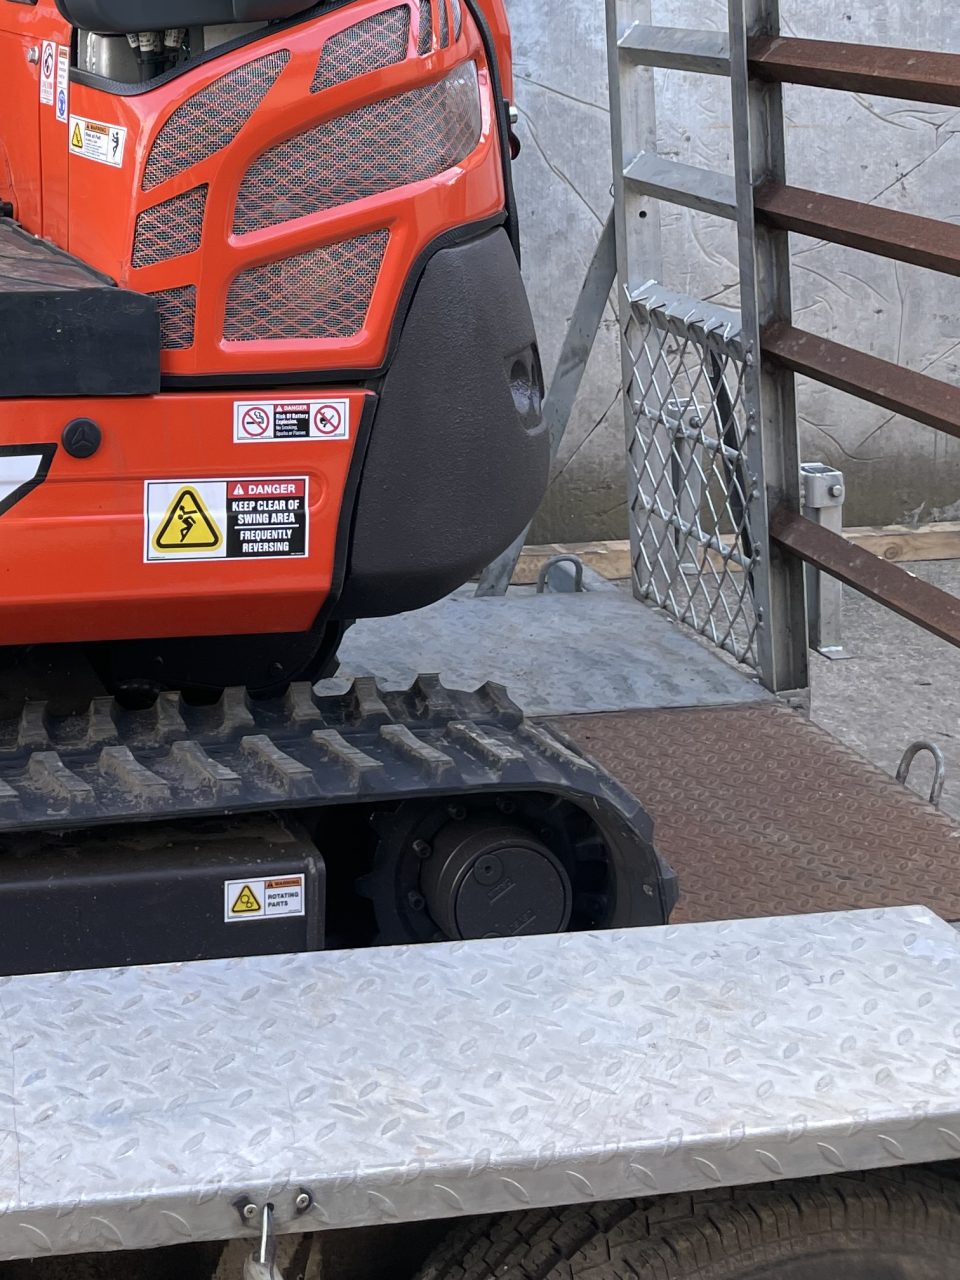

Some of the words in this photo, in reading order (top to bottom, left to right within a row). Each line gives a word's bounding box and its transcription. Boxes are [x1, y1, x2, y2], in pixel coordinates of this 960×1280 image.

[248, 484, 296, 494] DANGER
[232, 500, 255, 511] KEEP
[257, 500, 287, 511] CLEAR
[288, 499, 300, 510] OF
[237, 513, 269, 524] SWING
[270, 513, 296, 523] AREA
[240, 529, 292, 541] FREQUENTLY
[242, 542, 289, 553] REVERSING
[268, 891, 299, 900] ROTATING
[268, 900, 288, 908] PARTS
